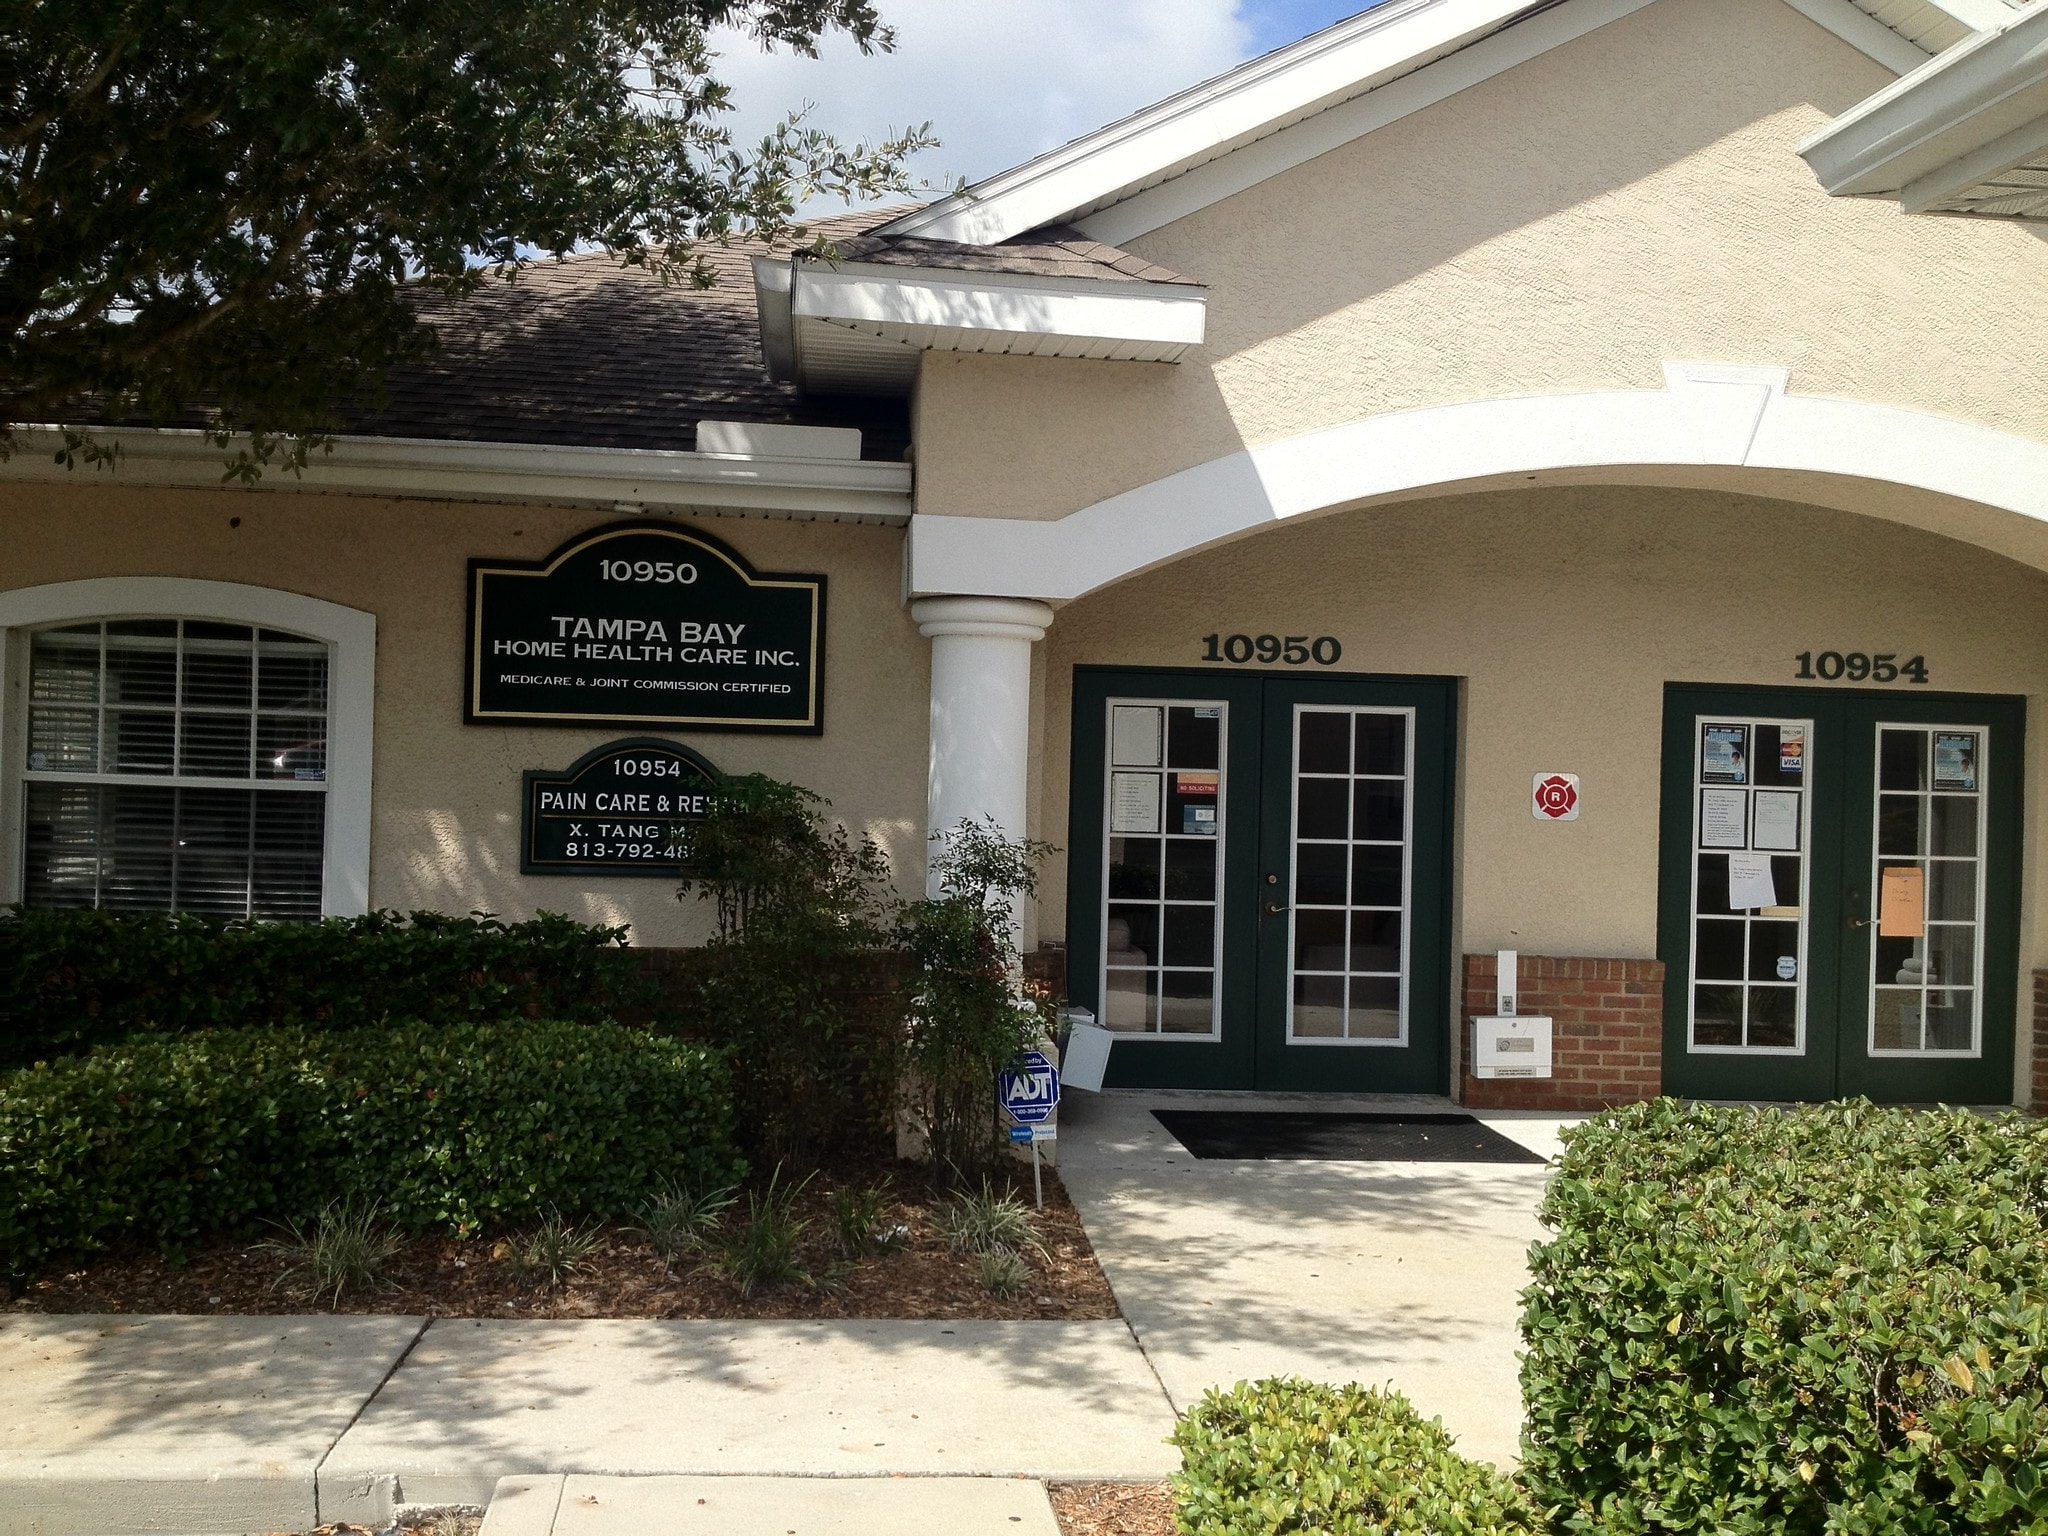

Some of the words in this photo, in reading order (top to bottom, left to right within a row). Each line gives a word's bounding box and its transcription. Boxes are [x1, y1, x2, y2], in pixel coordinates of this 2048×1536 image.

[600, 560, 698, 584] 10950
[551, 616, 667, 642] TAMPA
[680, 622, 746, 645] BAY
[494, 640, 566, 658] HOME
[574, 643, 673, 662] HEALTH
[680, 647, 747, 665] CARE
[755, 650, 800, 667] INC.
[1201, 634, 1342, 665] 10950
[1794, 651, 1929, 683] 10954
[500, 674, 572, 687] MEDICARE
[575, 677, 586, 687] &
[590, 678, 630, 689] JOINT
[633, 679, 719, 692] COMMISSION
[722, 682, 791, 694] CERTIFIED
[614, 759, 680, 777] 10954
[541, 792, 587, 810] PAIN
[595, 793, 650, 812] CARE
[657, 795, 670, 812] &
[1551, 791, 1561, 802] R
[569, 823, 589, 837] X.
[598, 824, 660, 838] TANG
[566, 842, 698, 859] 813-792-48
[1008, 1072, 1051, 1101] ADT
